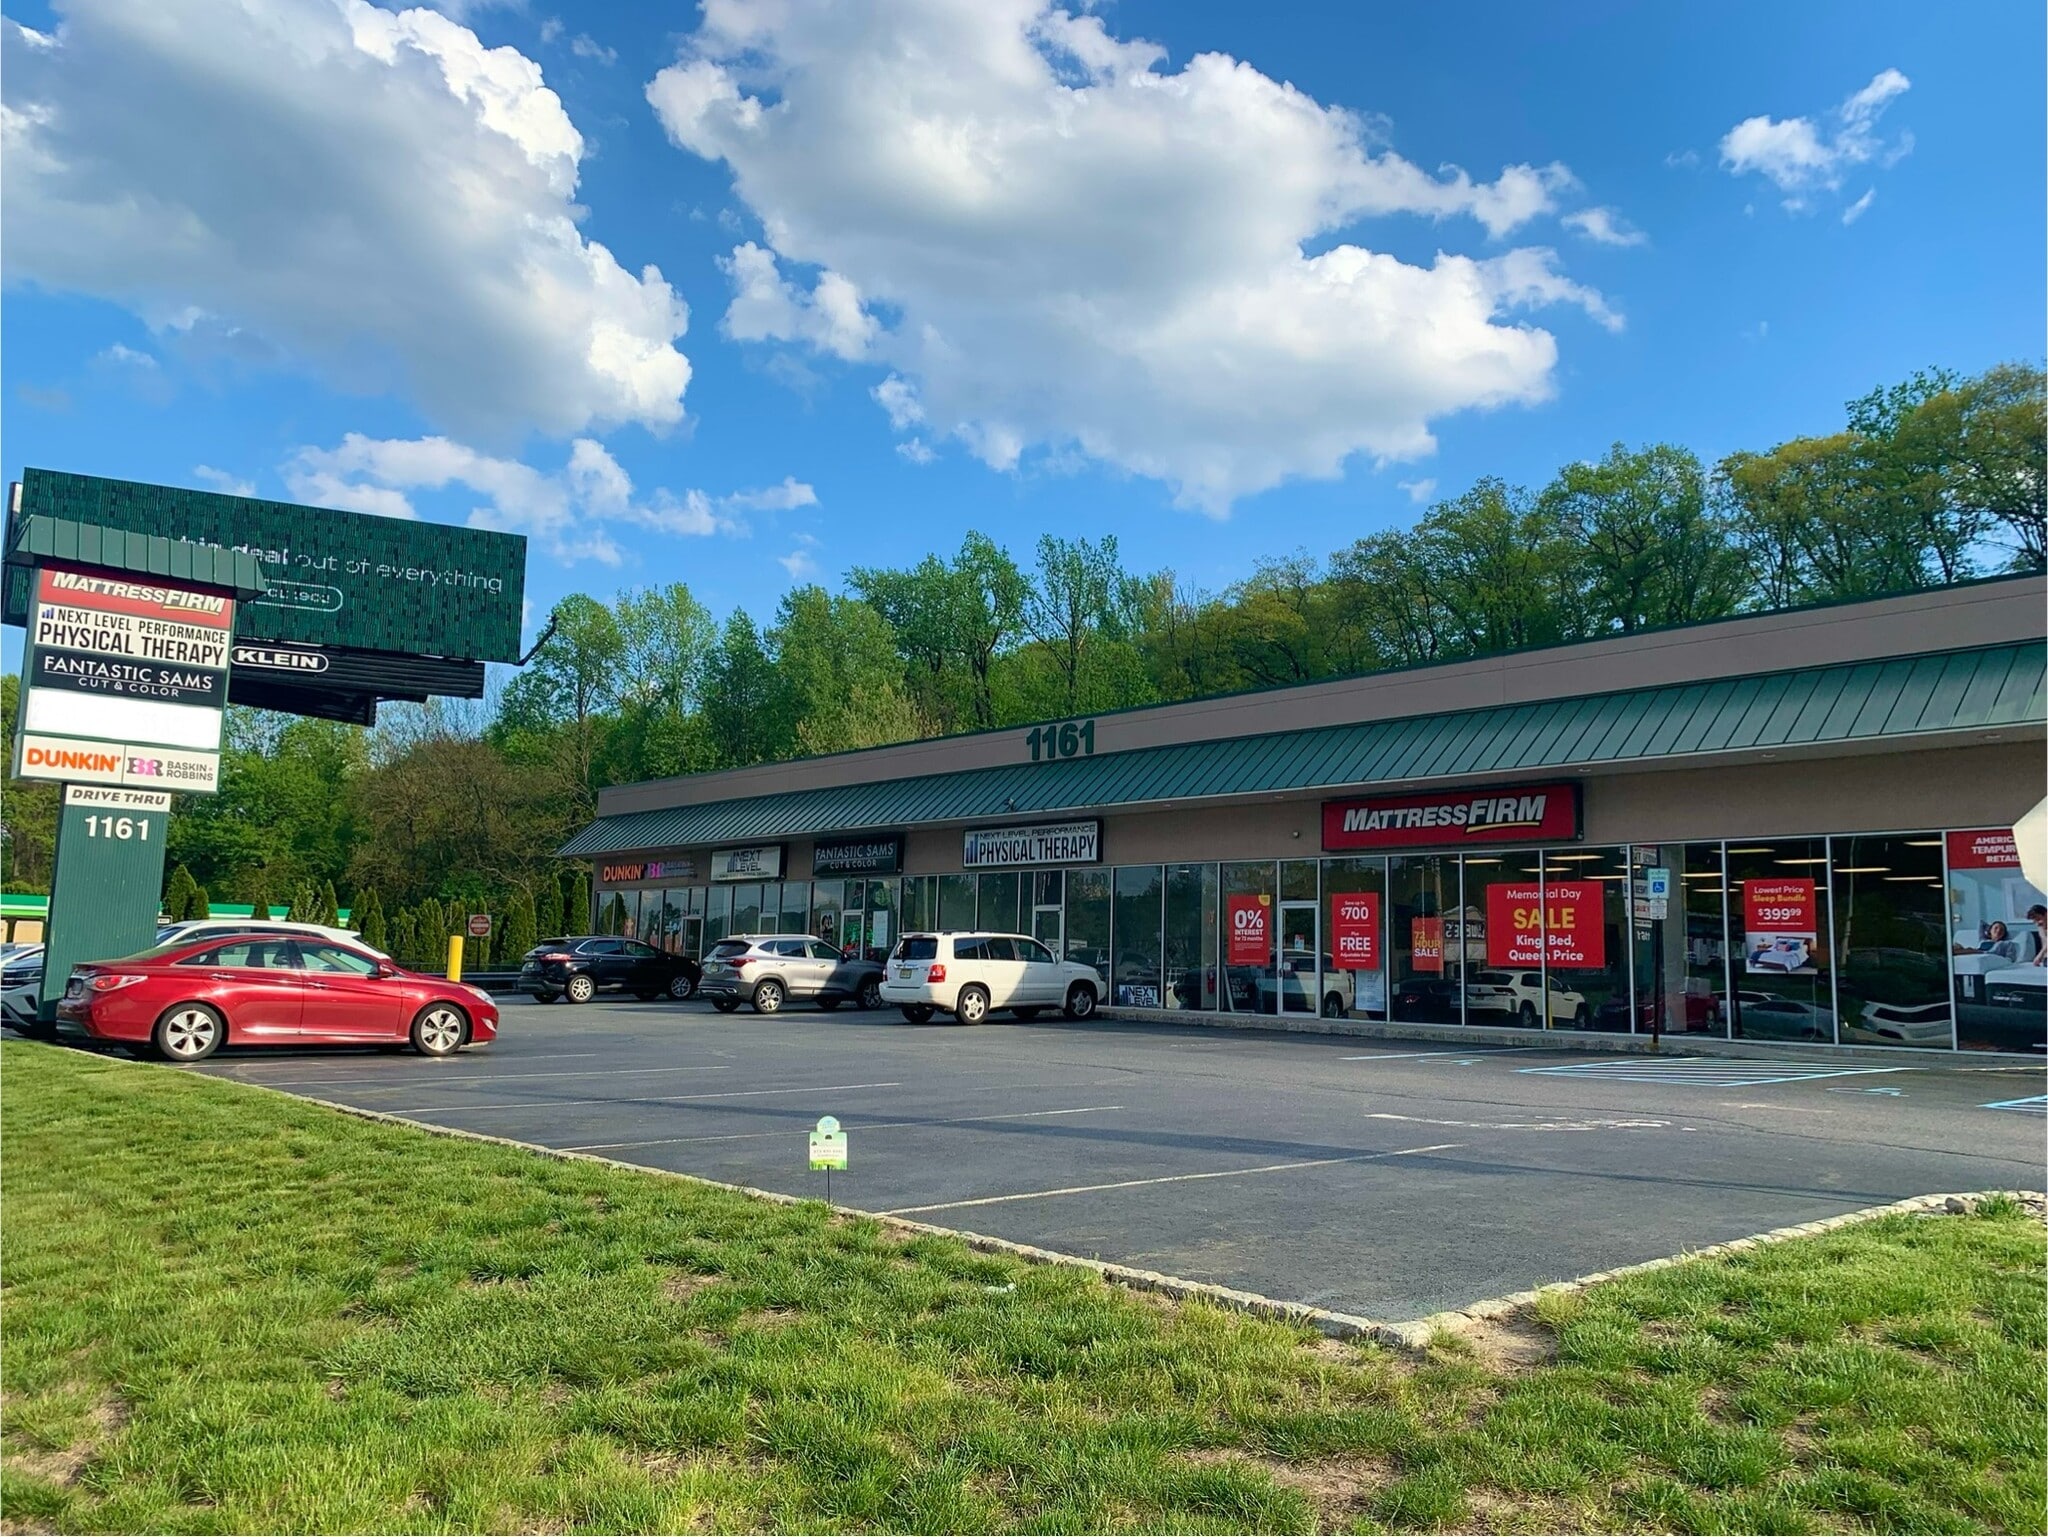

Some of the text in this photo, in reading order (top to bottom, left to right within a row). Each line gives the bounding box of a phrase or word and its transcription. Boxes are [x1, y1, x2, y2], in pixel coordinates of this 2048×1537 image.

[294, 553, 338, 571] out
[376, 564, 503, 594] everything
[52, 571, 226, 612] MATTRESSFIRM
[58, 608, 226, 645] NEXT LEVEL PERFORMANCE
[39, 622, 224, 667] PHYSICAL THERAPY
[237, 650, 320, 669] KLEIN
[44, 656, 213, 690] FANTASTIC SAMS
[78, 677, 180, 698] CUT & COLOR
[1026, 720, 1095, 761] 1161
[27, 748, 121, 773] DUNKIN'
[126, 757, 164, 777] BR
[167, 760, 209, 773] BASKIN
[166, 770, 214, 782] ROBBINS
[71, 789, 166, 806] DRIVE THRU
[1343, 796, 1547, 833] MATTRESSFIRM
[85, 815, 149, 841] 1161
[980, 825, 1096, 840] NEXT LEVEL PERFORMANCE
[1975, 836, 2015, 844] AMERIC
[734, 849, 763, 863] NEXT
[815, 842, 894, 860] FANTASTIC SAMS
[979, 834, 1096, 864] PHYSICAL THERAPY
[735, 862, 762, 873] LEVEL
[851, 859, 877, 867] COLOR
[603, 866, 644, 882] DUNKIN'
[1506, 888, 1581, 900] Memoial Day
[1752, 895, 1776, 904] Sleep
[1234, 909, 1264, 929] 0%
[1340, 906, 1369, 920] $700
[1513, 908, 1576, 929] SALE
[1340, 937, 1371, 951] FREE
[1414, 939, 1441, 949] HOUR
[1516, 934, 1575, 948] King Bed,
[1414, 948, 1439, 957] SALE
[1553, 949, 1584, 961] Price
[1128, 986, 1156, 997] NEXT
